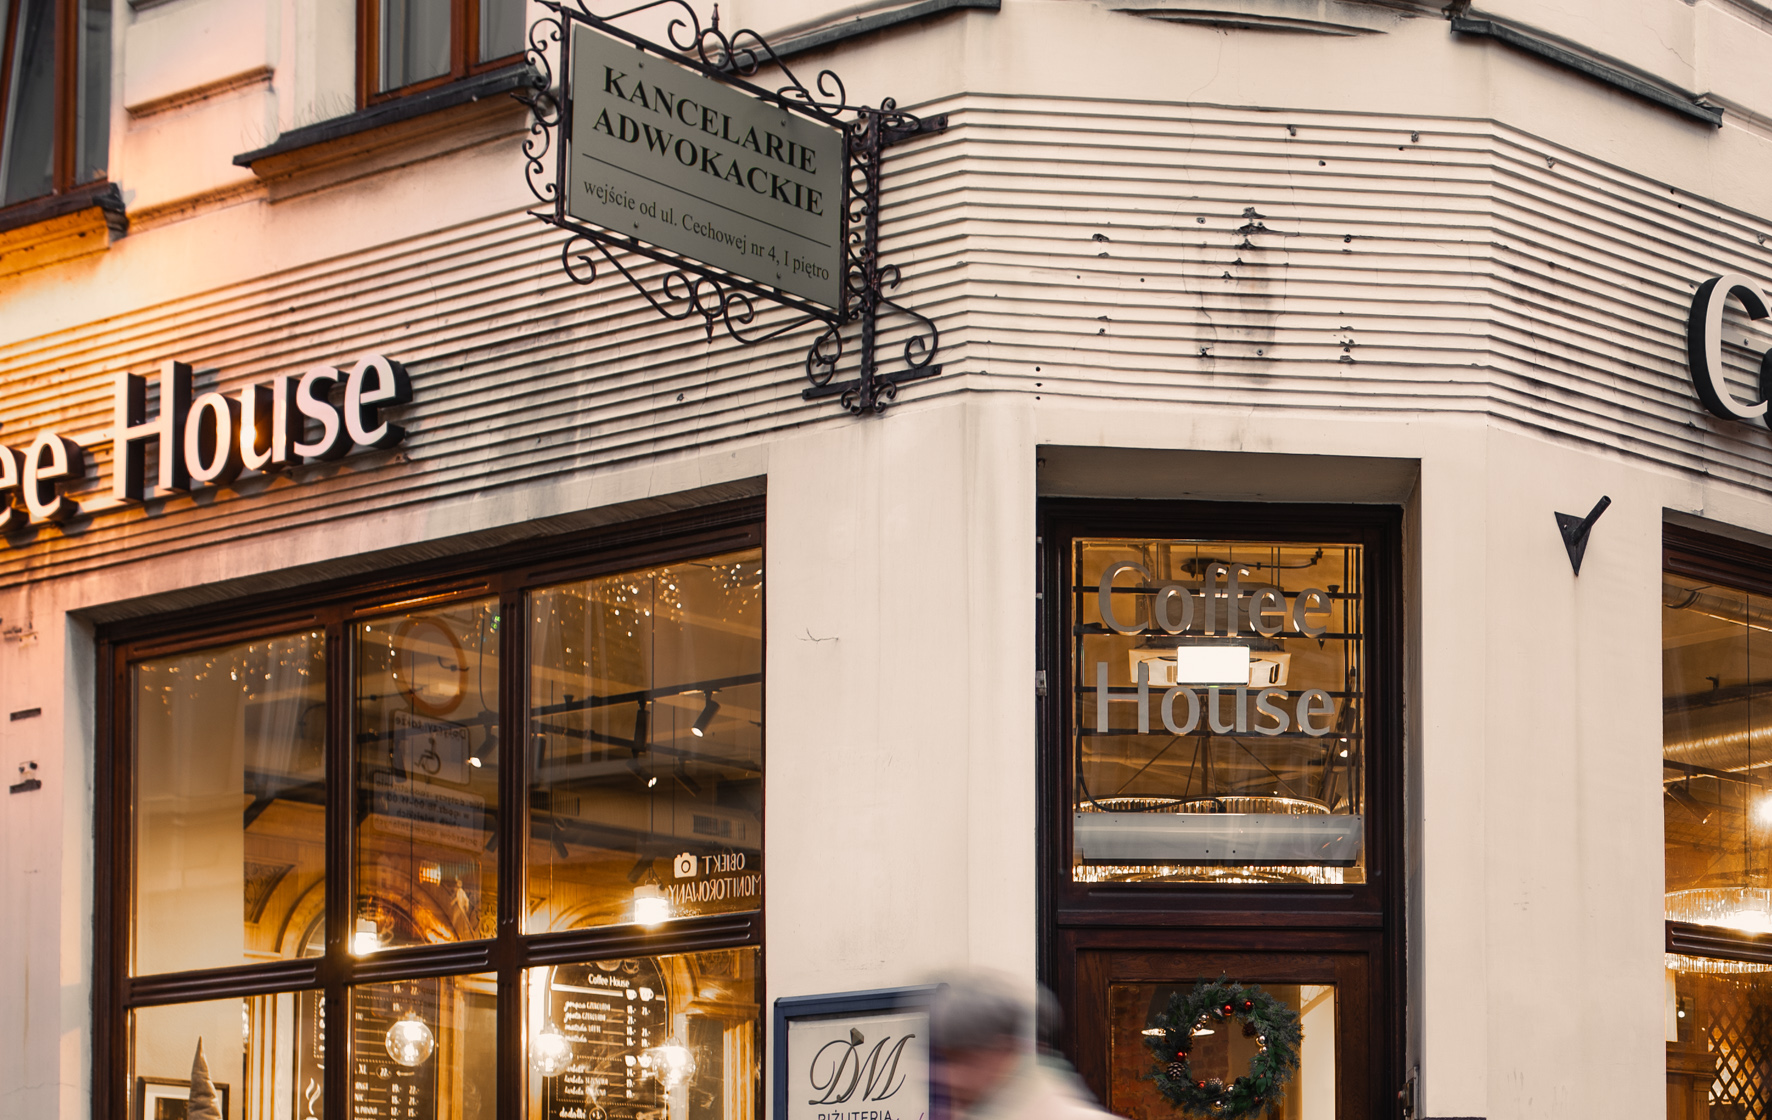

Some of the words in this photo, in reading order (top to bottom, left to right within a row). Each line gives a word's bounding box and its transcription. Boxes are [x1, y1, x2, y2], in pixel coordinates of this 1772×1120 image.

[592, 106, 824, 217] ADWOKACKIE
[602, 65, 817, 175] KANCELARIE
[583, 180, 635, 211] wejście
[640, 195, 656, 219] od
[660, 202, 678, 227] ul.
[682, 213, 748, 255] Cechowej
[750, 241, 766, 259] nr
[768, 245, 781, 265] 4,
[783, 251, 790, 268] I
[792, 253, 830, 282] piętro
[113, 354, 413, 500] House
[1098, 561, 1333, 638] Coffee
[1096, 661, 1336, 737] House
[588, 973, 609, 986] Coffee
[609, 976, 631, 988] House
[808, 1033, 916, 1105] DM
